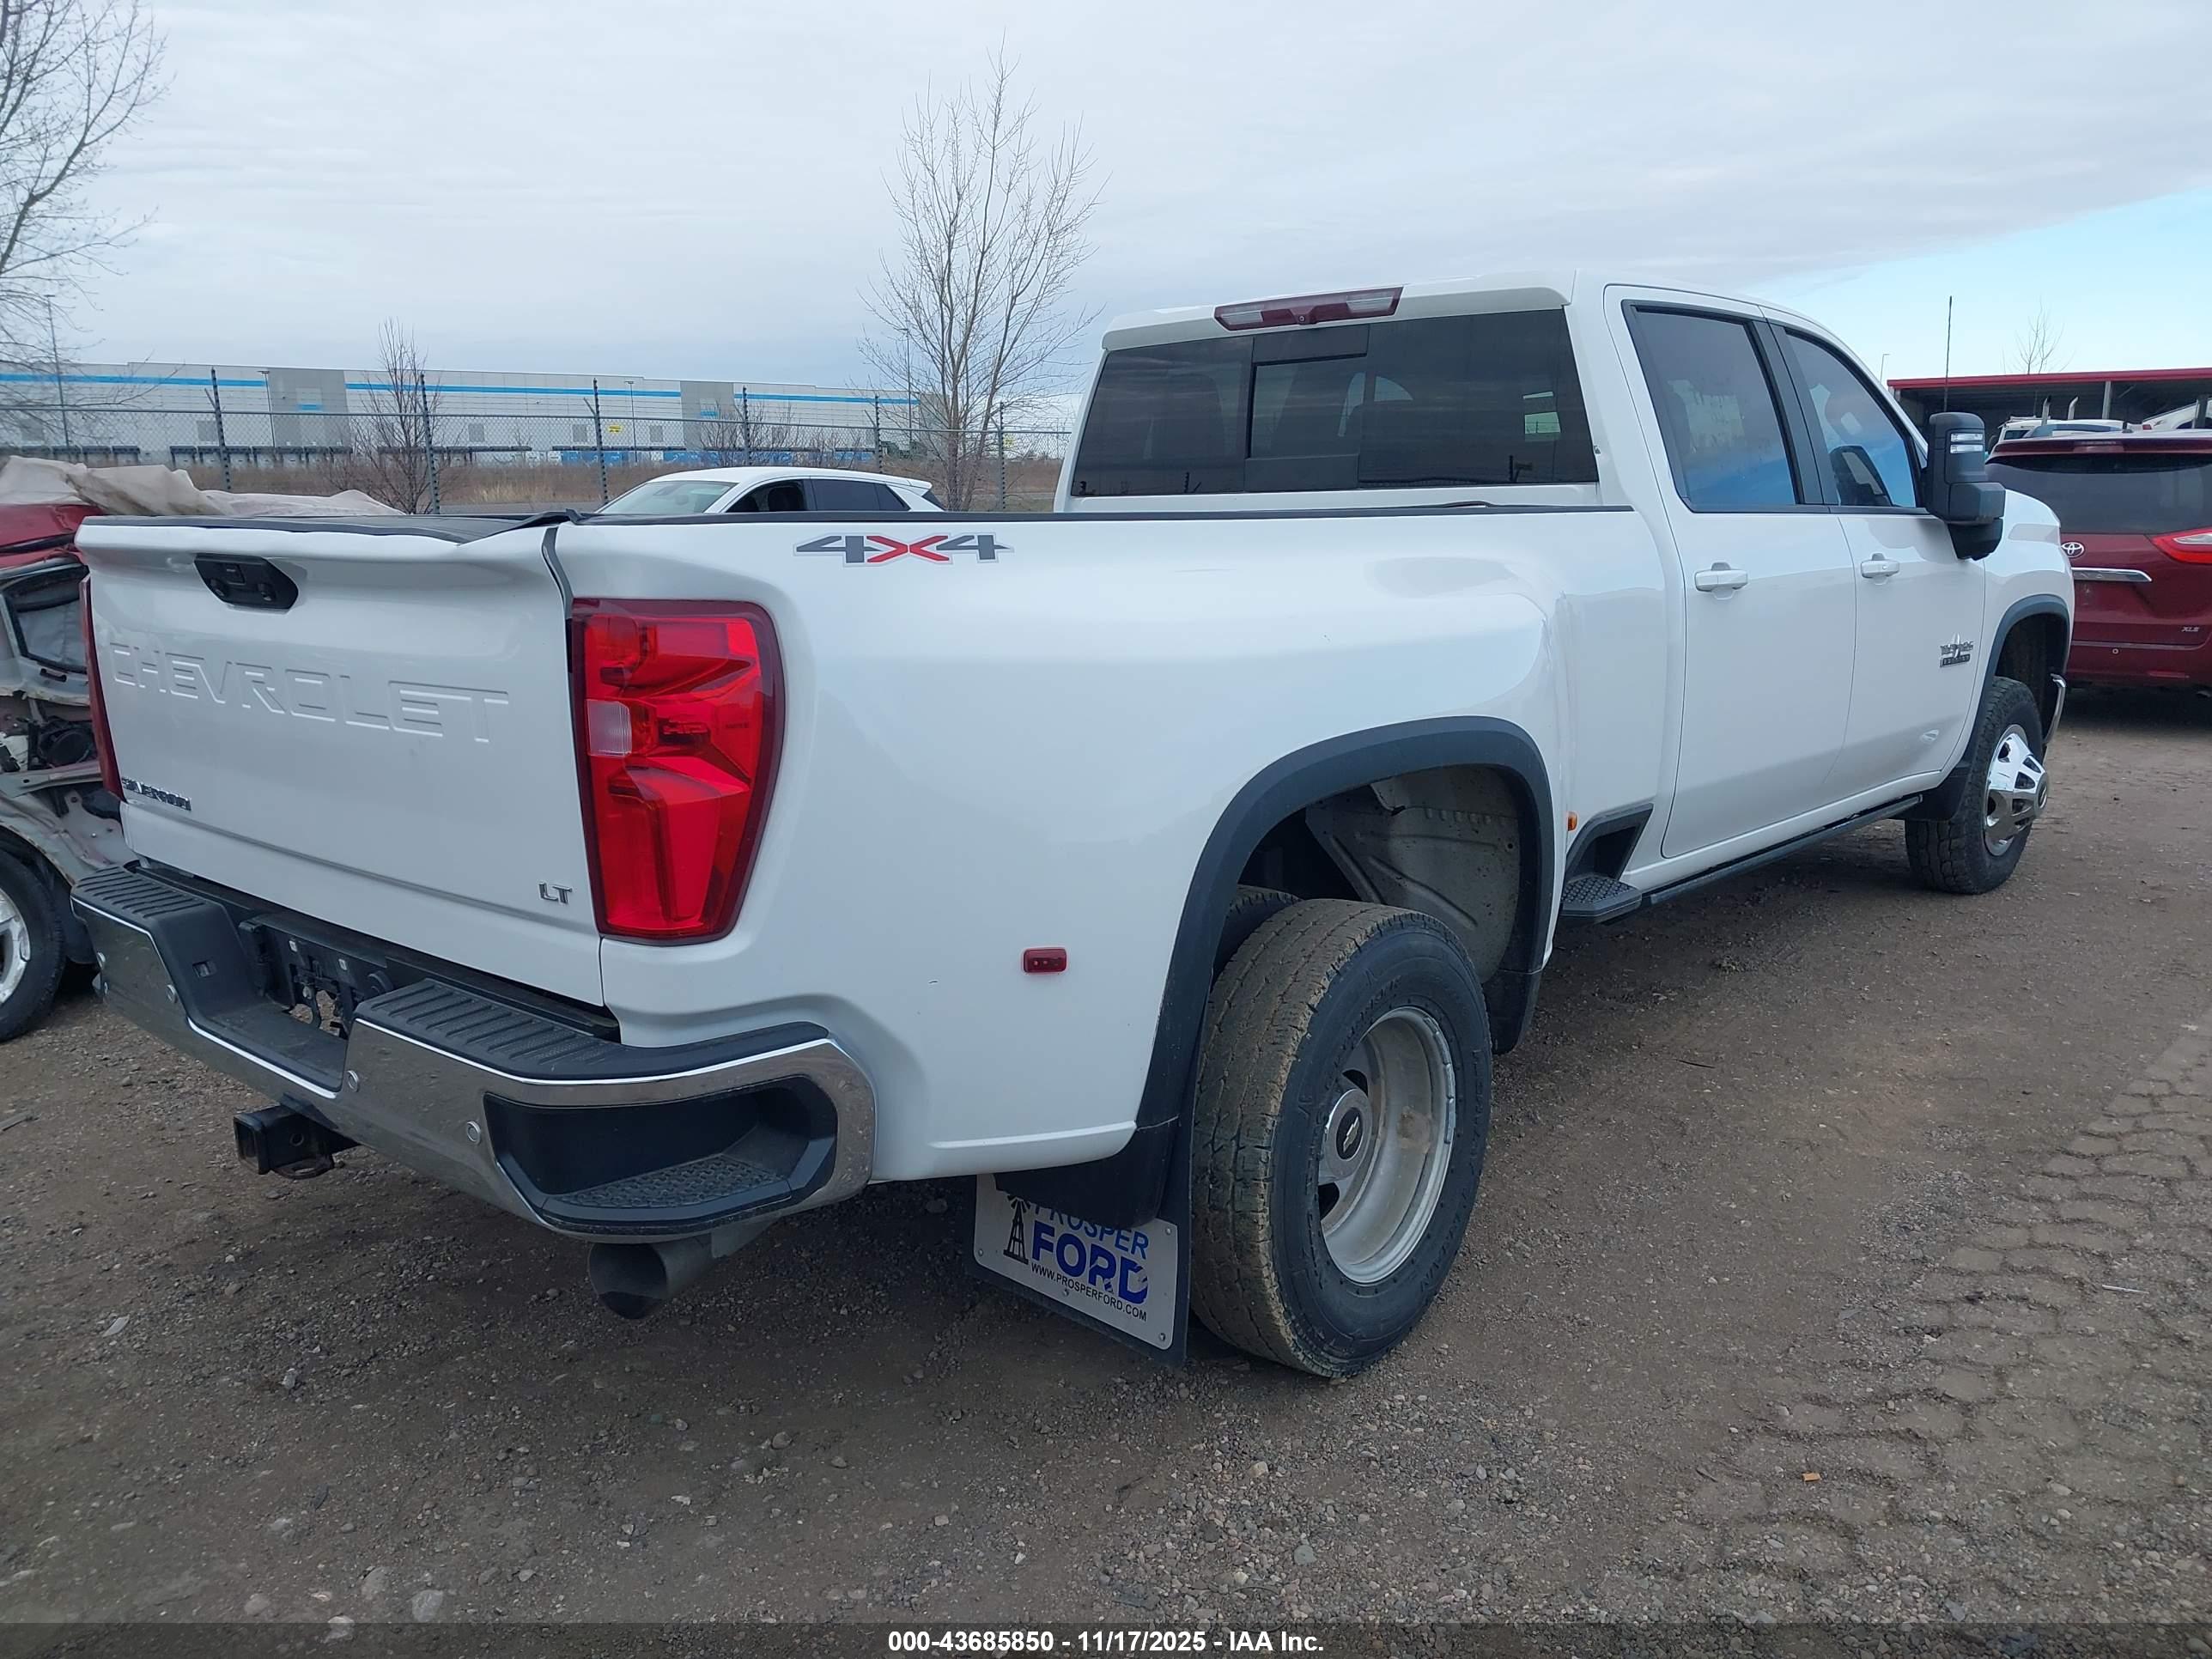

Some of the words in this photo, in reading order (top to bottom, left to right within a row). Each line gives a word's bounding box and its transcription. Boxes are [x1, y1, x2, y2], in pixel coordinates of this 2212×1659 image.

[109, 641, 509, 743] CHEVROLET
[538, 881, 573, 904] LT
[1031, 1262, 1147, 1322] WWW.PROSPERFORD.COM
[1032, 1219, 1149, 1305] FORD
